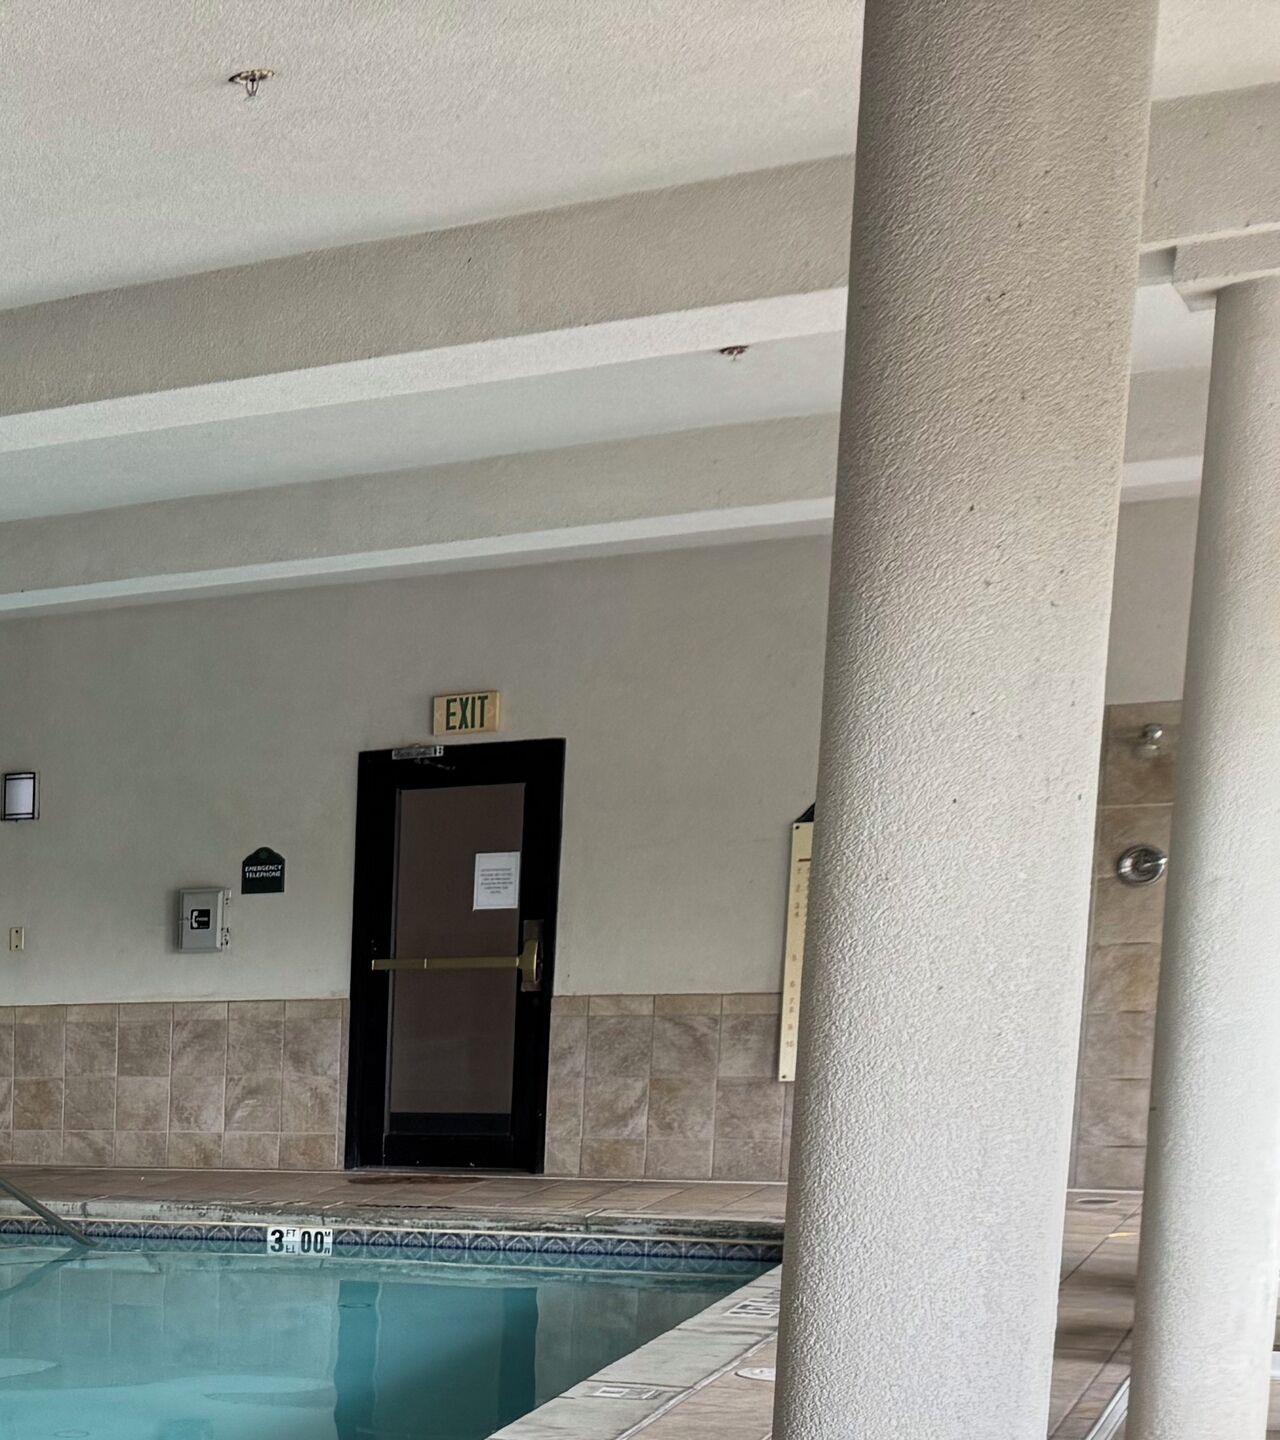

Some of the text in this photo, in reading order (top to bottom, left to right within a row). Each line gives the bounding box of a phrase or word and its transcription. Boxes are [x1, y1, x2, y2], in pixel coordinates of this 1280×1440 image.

[446, 695, 489, 731] EXIT
[270, 1229, 284, 1252] 3
[286, 1229, 296, 1237] FT
